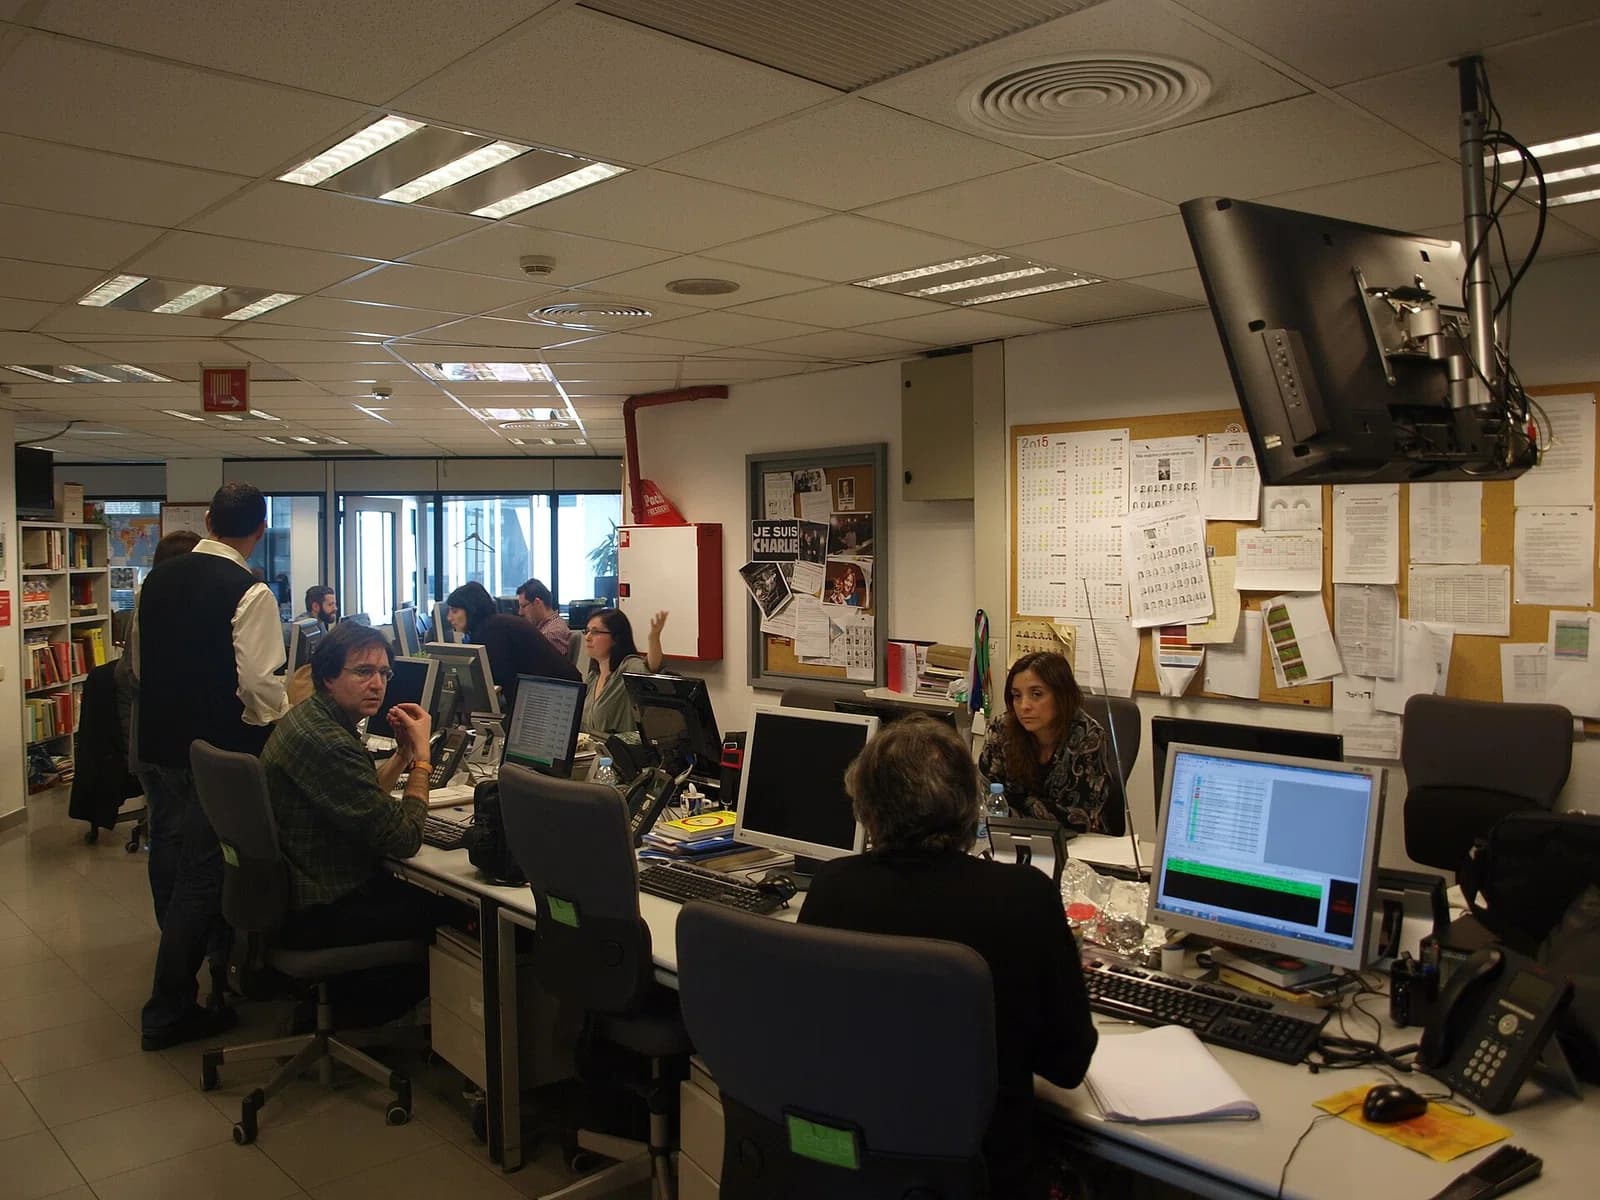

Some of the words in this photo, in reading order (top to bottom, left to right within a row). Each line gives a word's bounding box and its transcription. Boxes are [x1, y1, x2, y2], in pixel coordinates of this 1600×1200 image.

[753, 526, 771, 537] JE
[773, 526, 798, 537] SUIS
[753, 538, 798, 553] CHARLIE
